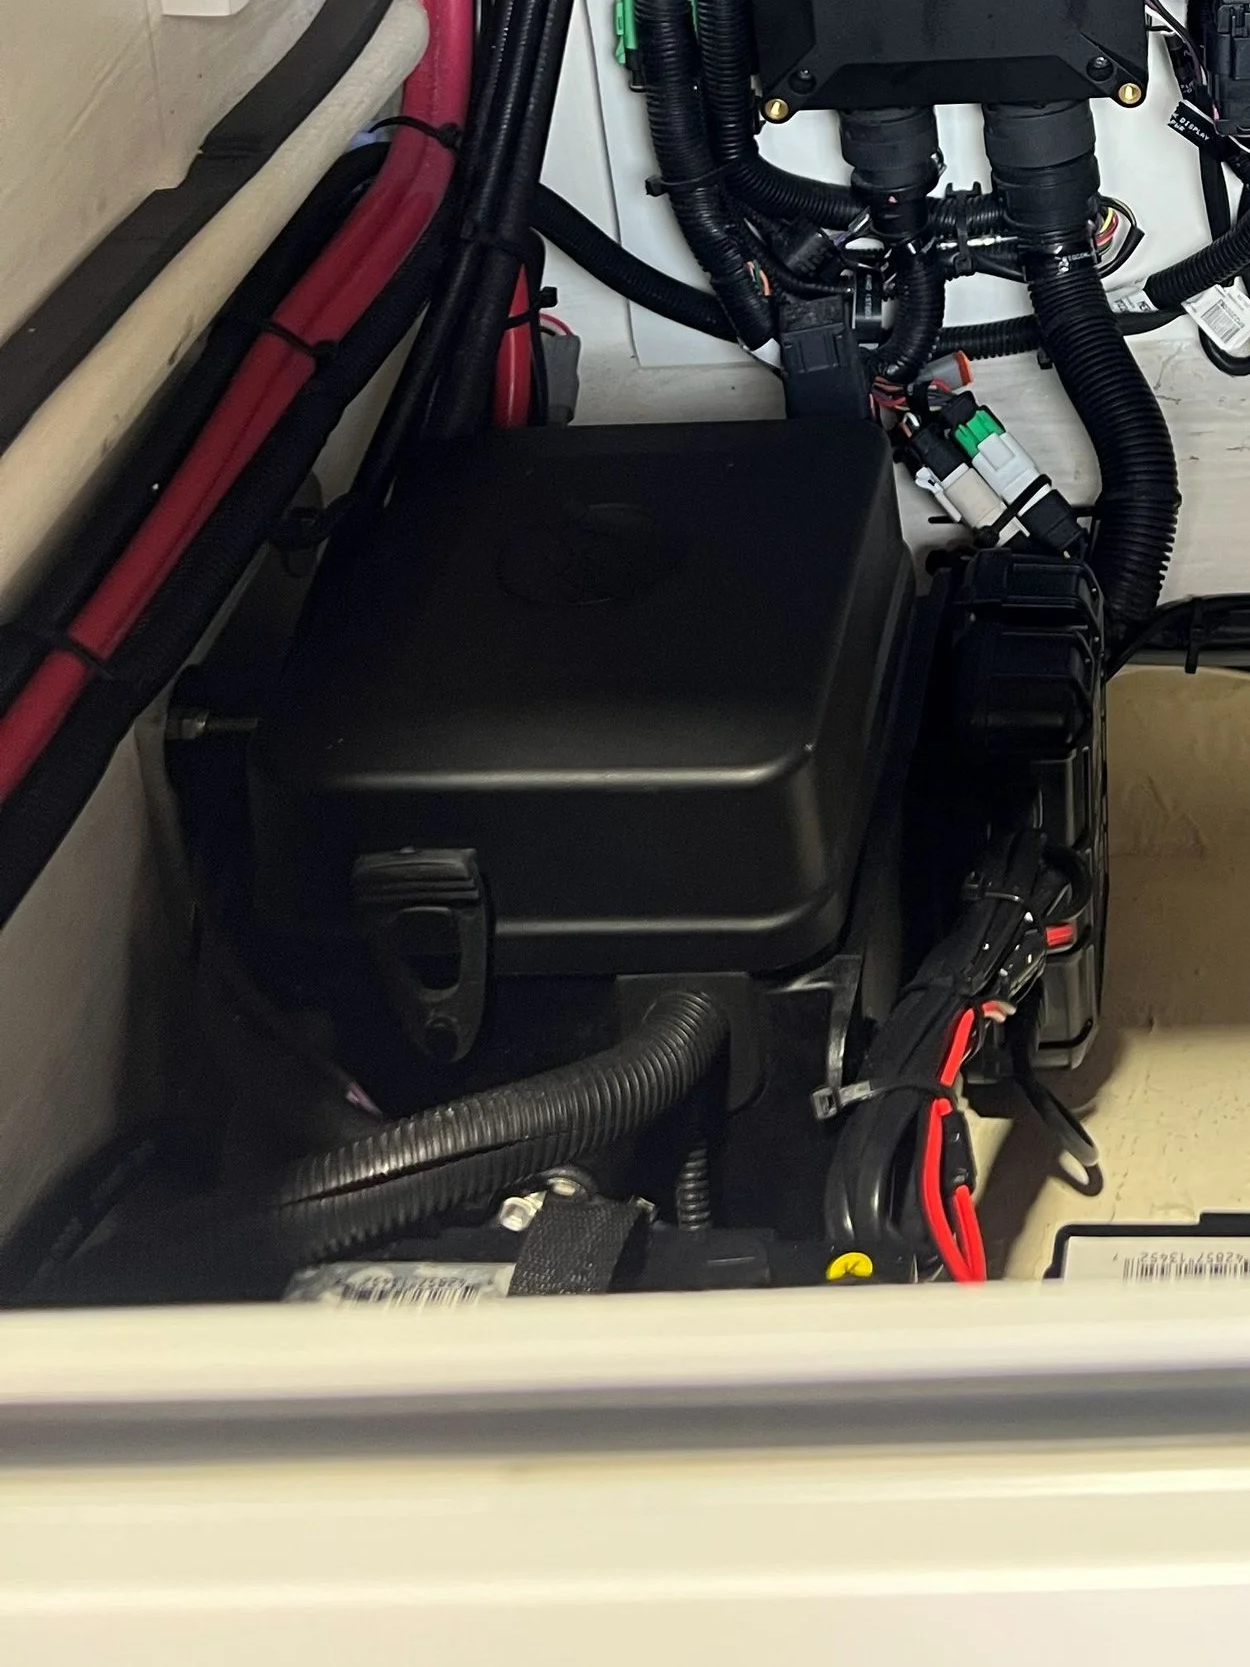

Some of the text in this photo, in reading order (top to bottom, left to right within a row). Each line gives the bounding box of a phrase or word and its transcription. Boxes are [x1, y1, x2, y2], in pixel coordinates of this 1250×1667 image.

[1178, 116, 1211, 141] DISPLAY
[1140, 1252, 1186, 1263] 13452
[1198, 1252, 1243, 1263] 42857
